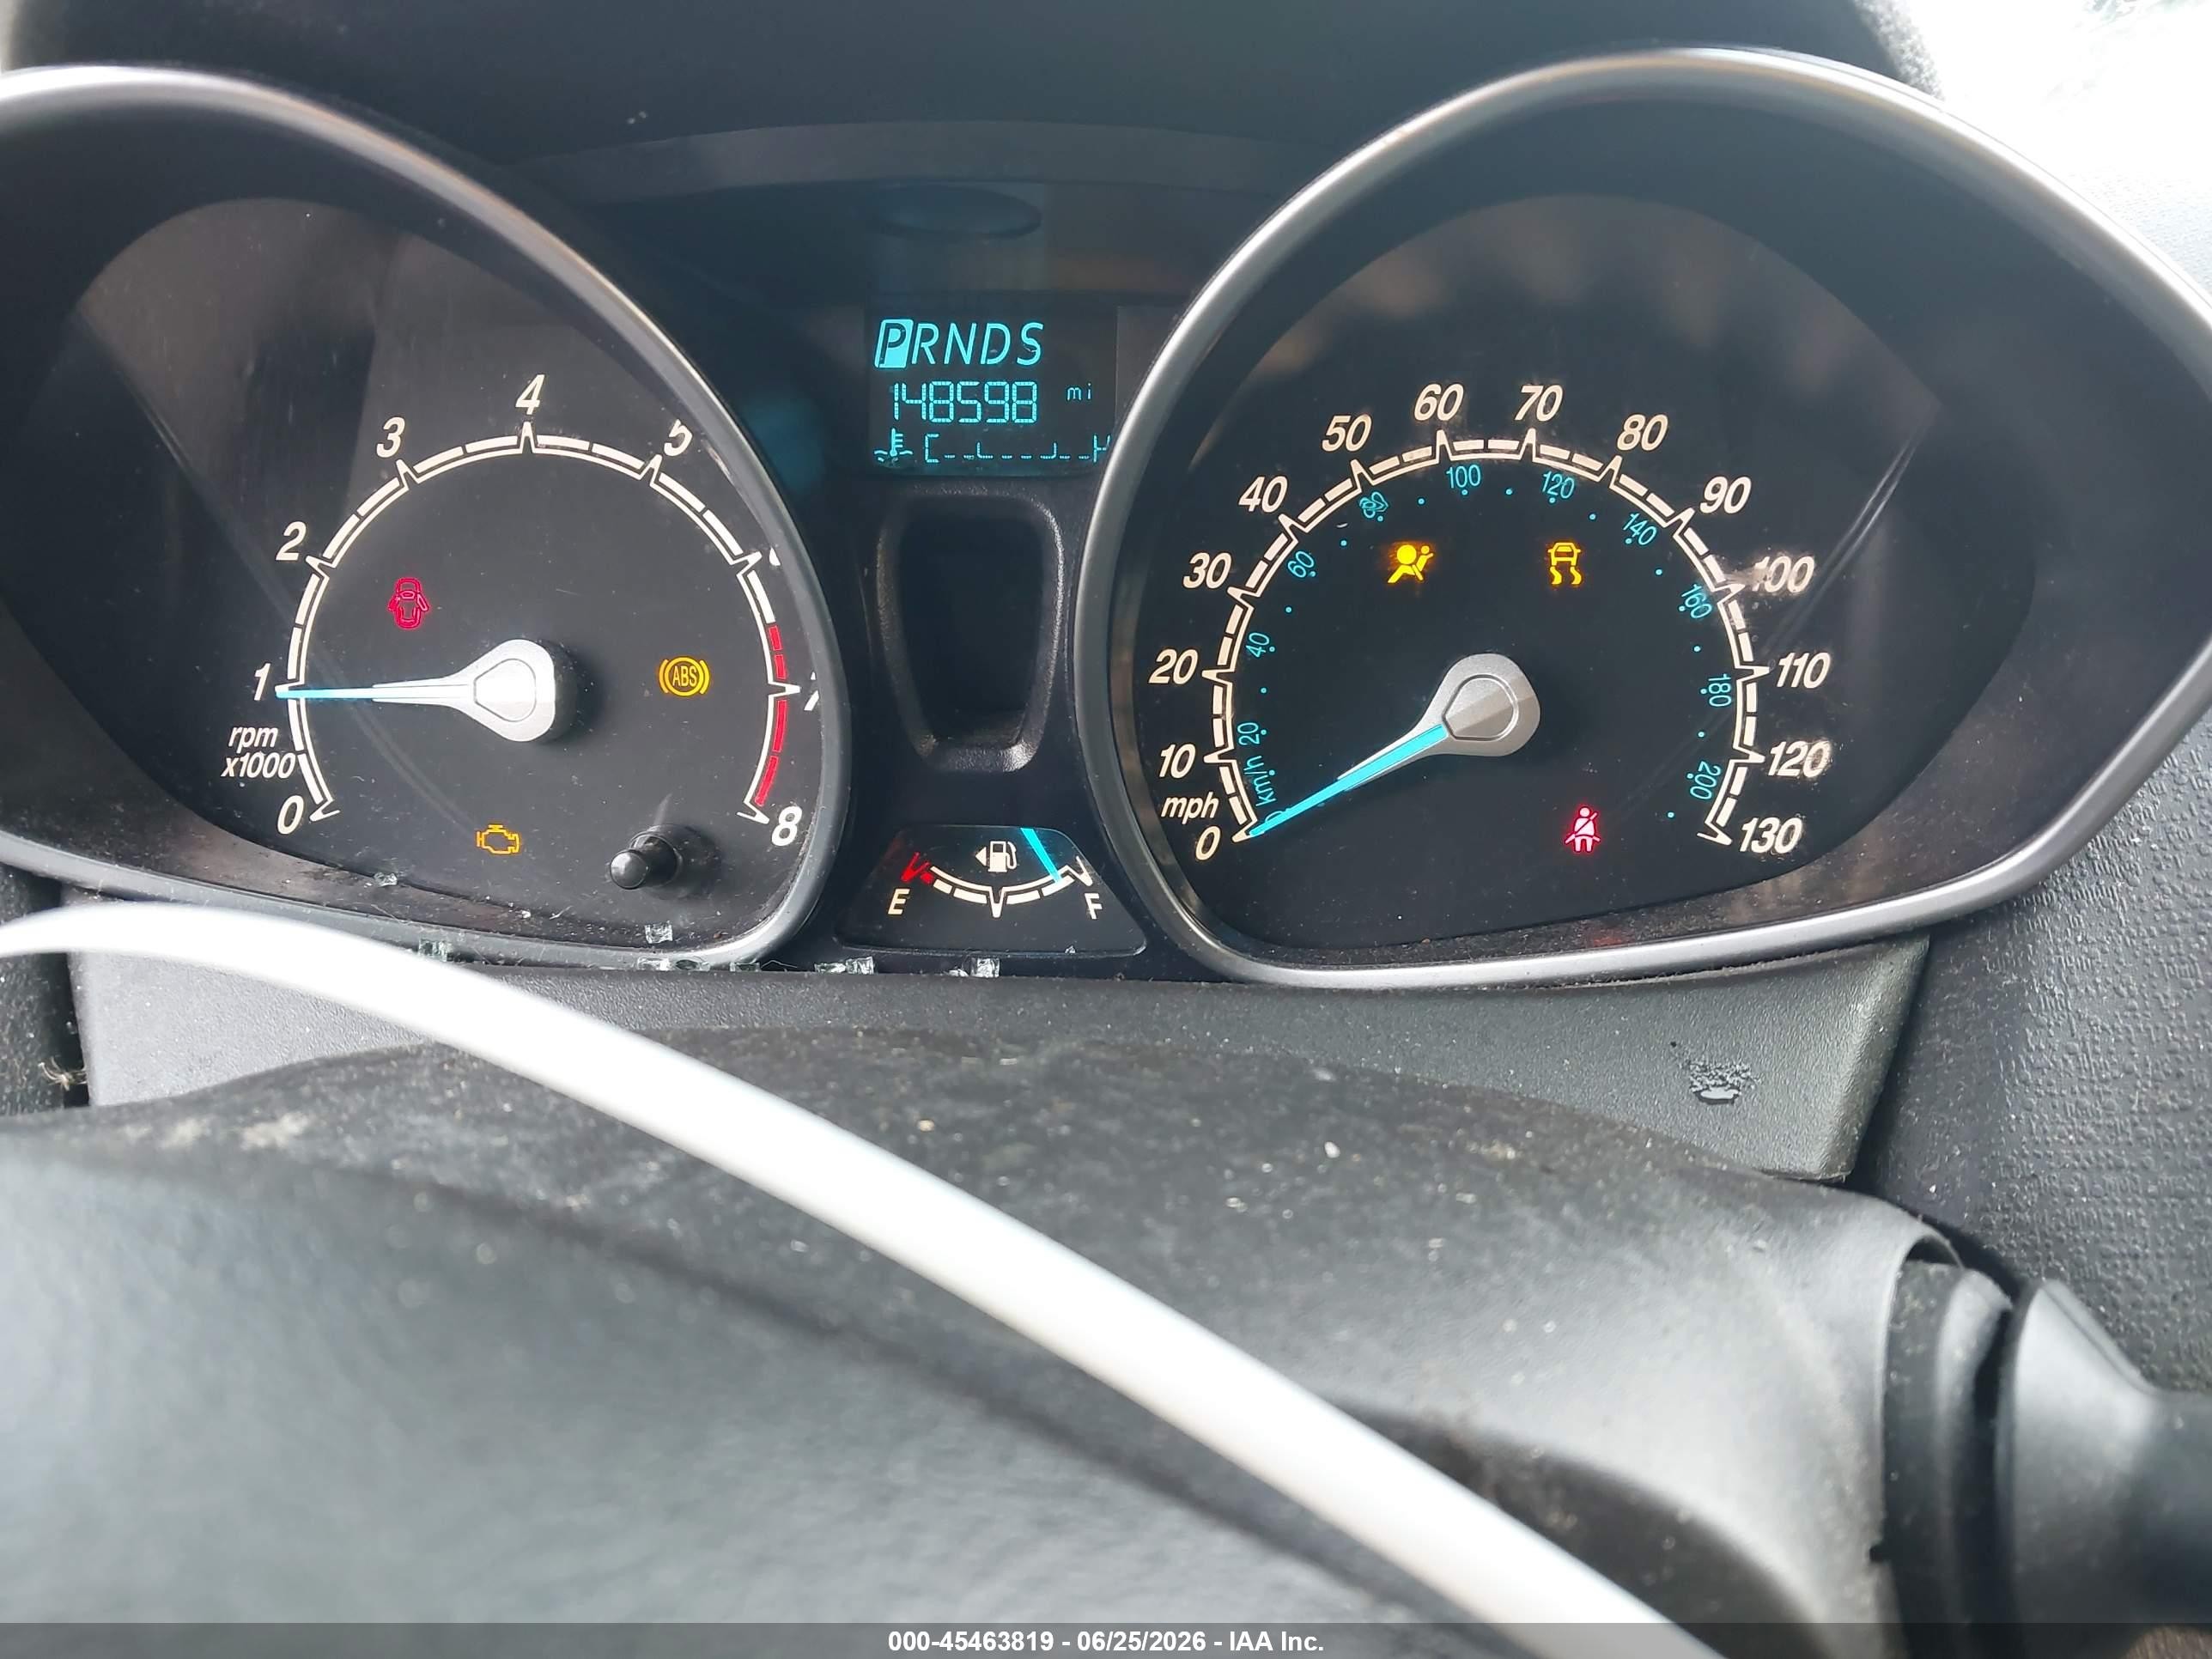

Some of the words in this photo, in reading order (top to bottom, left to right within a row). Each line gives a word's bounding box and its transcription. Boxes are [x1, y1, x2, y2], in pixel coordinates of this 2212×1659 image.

[515, 374, 545, 416] 4
[894, 380, 1037, 423] 148598
[1066, 383, 1091, 401] mi
[1413, 383, 1464, 422] 60
[1515, 385, 1563, 422] 70
[376, 416, 405, 458] 3
[1322, 414, 1372, 452] 50
[1617, 414, 1668, 451] 80
[1238, 476, 1288, 513] 40
[1446, 464, 1481, 489] 100
[1542, 471, 1575, 500] 120
[1699, 476, 1752, 514] 90
[276, 520, 307, 561] 2
[1622, 512, 1657, 546] 140
[1182, 552, 1232, 589] 30
[1288, 550, 1315, 579] 60
[1753, 555, 1814, 593] 100
[1680, 583, 1713, 619] 160
[1245, 631, 1270, 659] 40
[253, 664, 270, 701] 1
[672, 665, 698, 688] ABS
[1148, 648, 1199, 684] 20
[1777, 652, 1832, 689] 110
[1708, 673, 1732, 708] 180
[228, 726, 278, 750] rpm
[1237, 722, 1260, 745] 20
[220, 750, 295, 779] x1000
[1159, 744, 1196, 779] 10
[1769, 740, 1831, 778] 120
[1243, 755, 1277, 807] km/h
[1690, 760, 1722, 799] 200
[276, 794, 304, 835] 0
[771, 806, 801, 847] 8
[1161, 792, 1219, 825] mph
[1194, 825, 1221, 860] 0
[1740, 817, 1803, 854] 130
[887, 888, 910, 915] E
[1084, 892, 1103, 920] F
